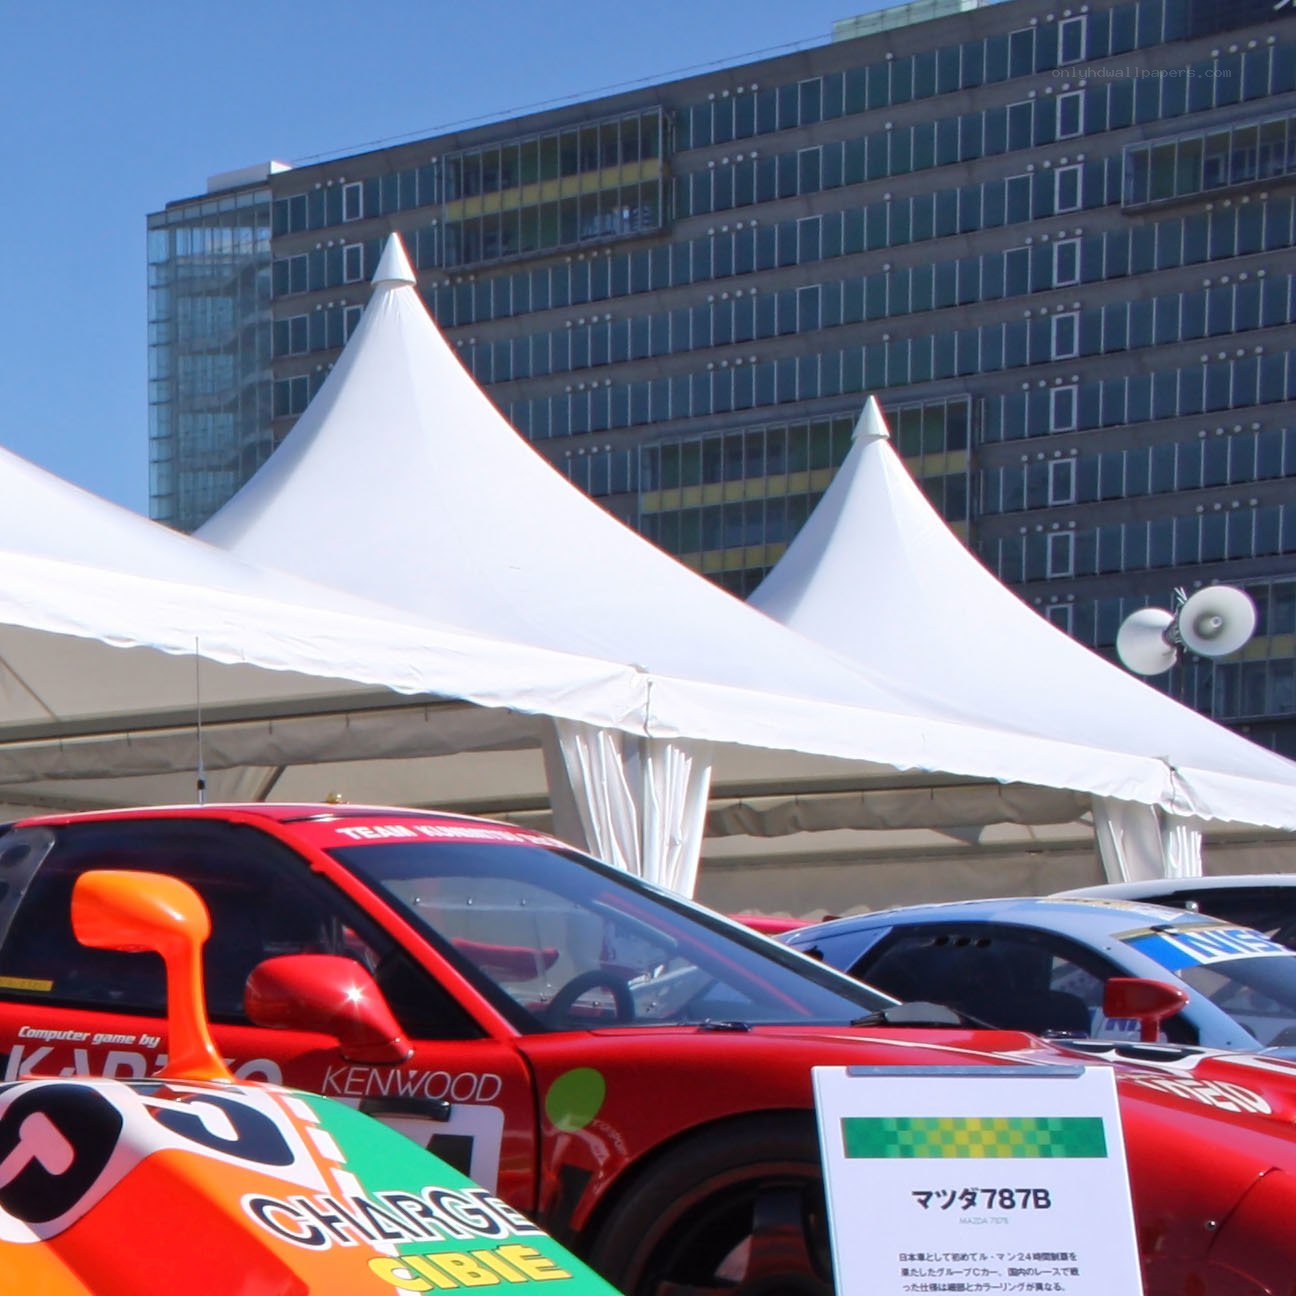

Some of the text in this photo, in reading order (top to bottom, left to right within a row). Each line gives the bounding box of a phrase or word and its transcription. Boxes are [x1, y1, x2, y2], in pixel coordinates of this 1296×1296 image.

[335, 825, 418, 841] TEAM
[18, 1026, 160, 1048] Computer game by
[320, 1065, 504, 1102] KENWOOD
[911, 1187, 1052, 1211] マツダ787B
[239, 1185, 550, 1252] CHARGE
